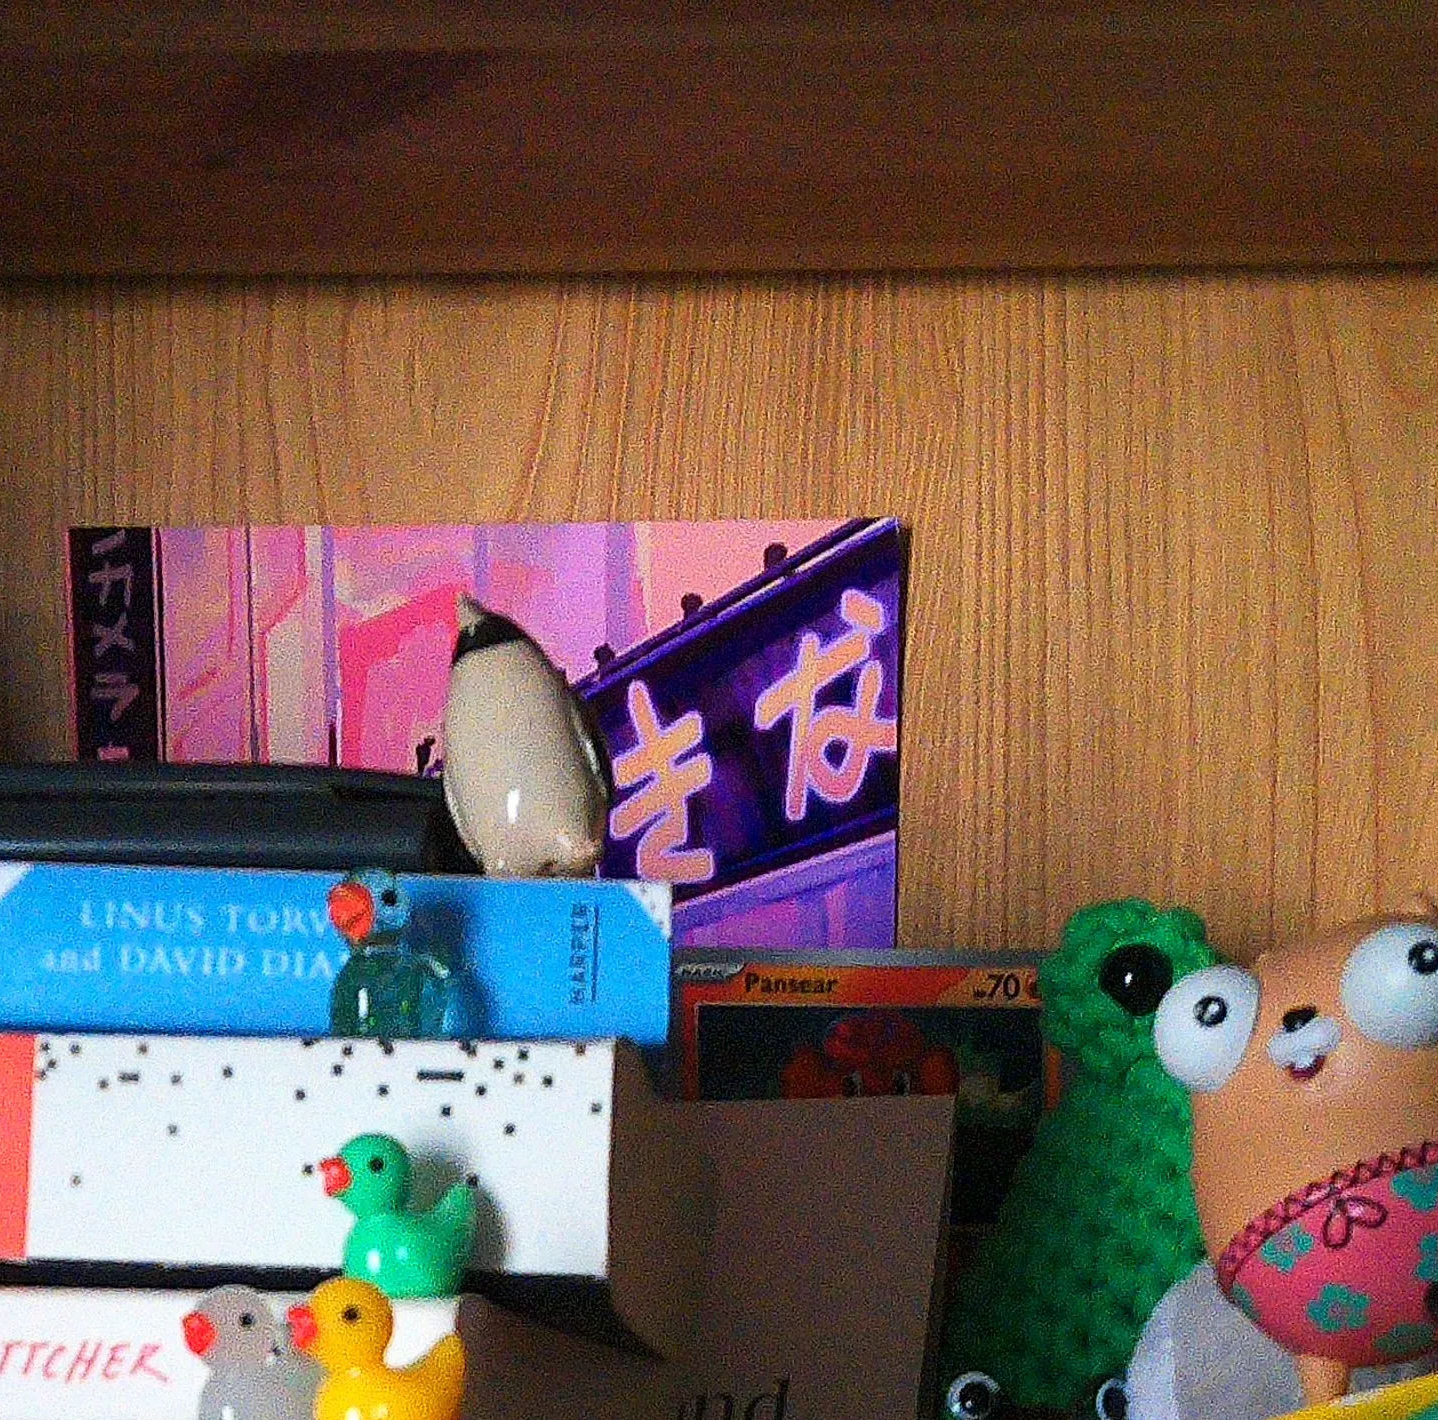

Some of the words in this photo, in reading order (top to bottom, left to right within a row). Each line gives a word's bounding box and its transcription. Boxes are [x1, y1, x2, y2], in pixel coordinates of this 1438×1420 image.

[79, 897, 206, 932] LINUS
[223, 902, 333, 936] TORV
[119, 946, 245, 978] DAVID
[262, 949, 347, 980] DIA
[745, 972, 839, 996] Pansear
[987, 973, 1021, 999] 70
